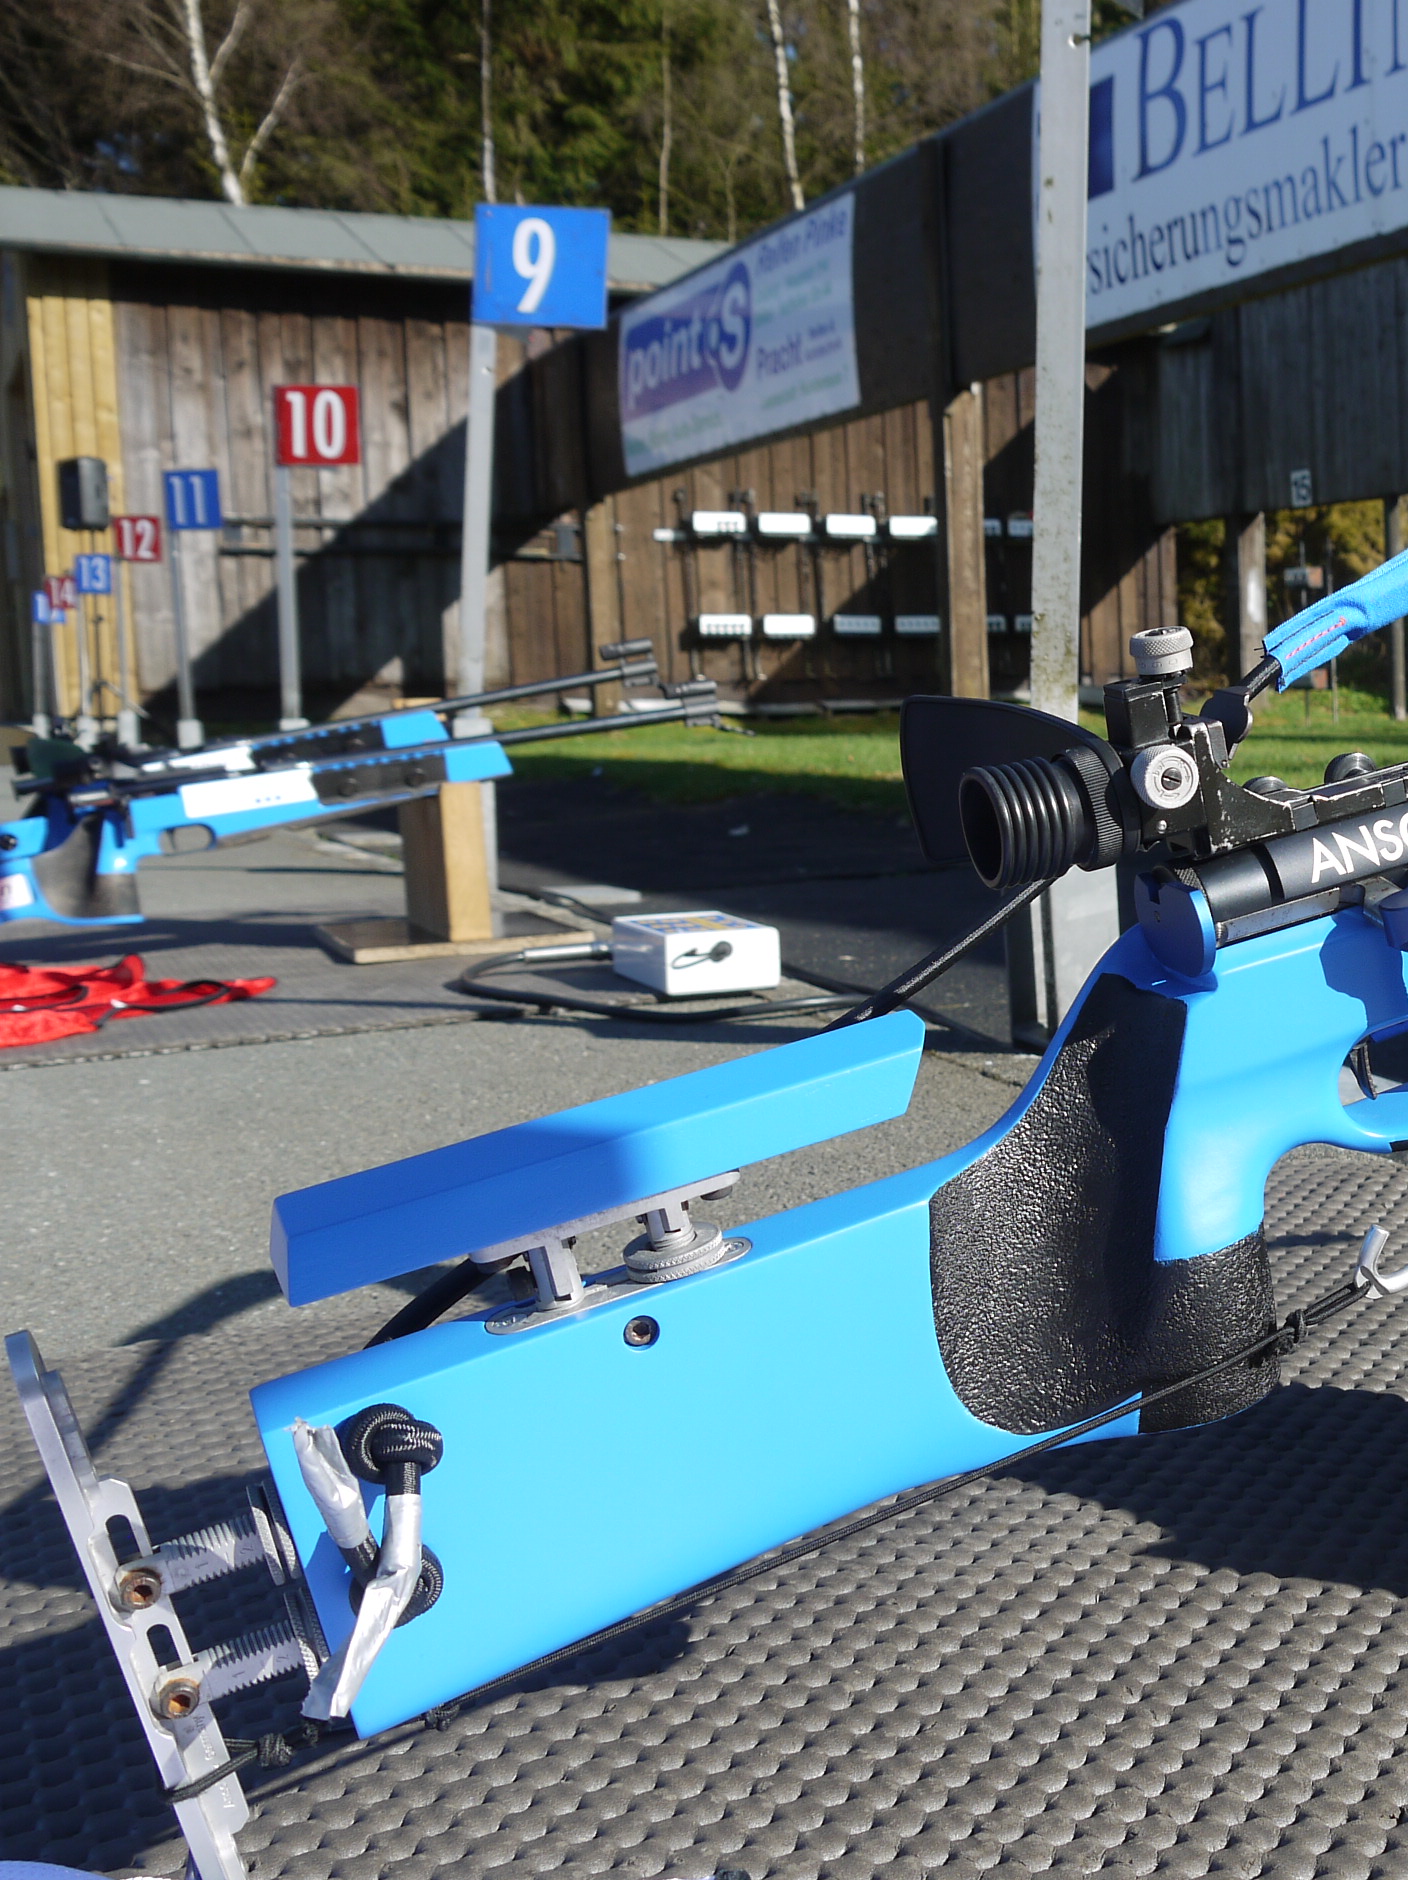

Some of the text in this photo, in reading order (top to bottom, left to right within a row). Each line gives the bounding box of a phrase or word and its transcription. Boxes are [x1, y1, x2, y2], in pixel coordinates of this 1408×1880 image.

[512, 217, 555, 313] 9
[627, 309, 702, 411] point
[285, 389, 346, 459] 10
[169, 475, 208, 526] 11
[119, 518, 156, 560] 12
[51, 577, 77, 608] 14
[79, 556, 107, 591] 13
